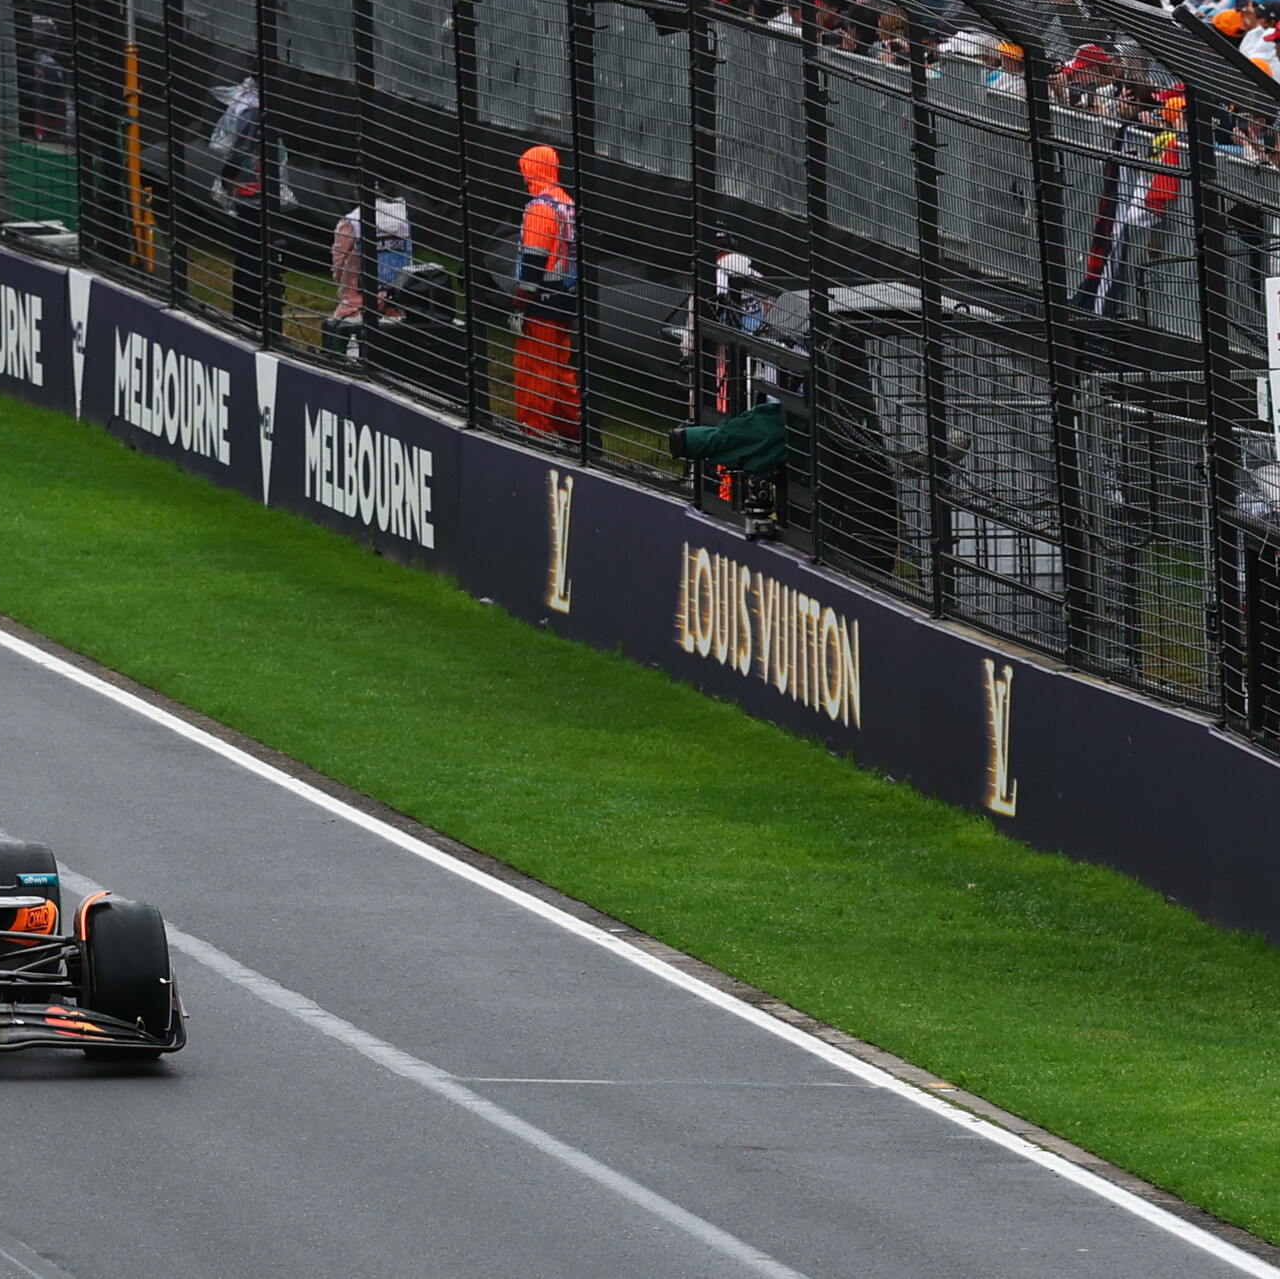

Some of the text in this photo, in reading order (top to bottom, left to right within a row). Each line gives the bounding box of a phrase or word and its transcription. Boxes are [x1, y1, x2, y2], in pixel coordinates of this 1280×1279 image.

[114, 323, 231, 467] MELBOURNE
[304, 402, 436, 550] MELBOURNE
[677, 541, 861, 730] LOUIS VUITTON
